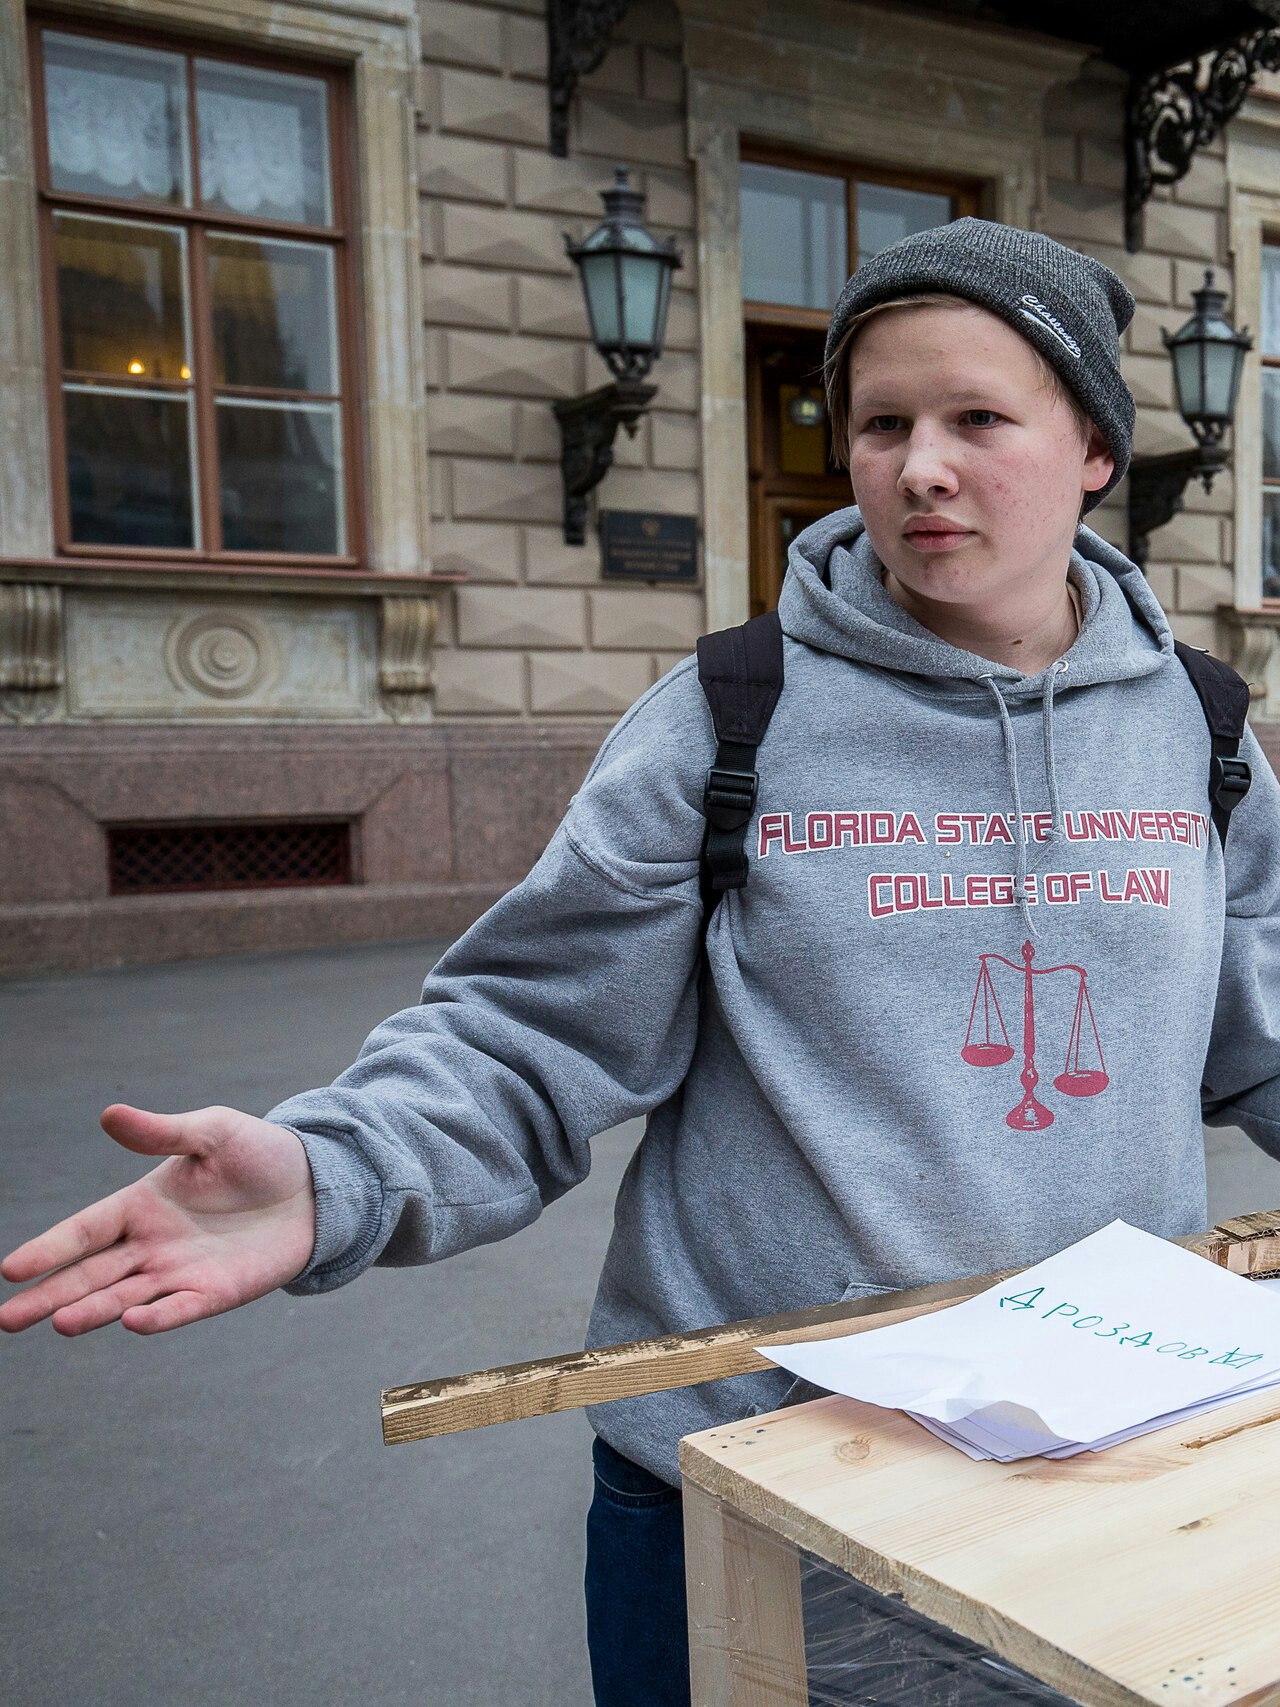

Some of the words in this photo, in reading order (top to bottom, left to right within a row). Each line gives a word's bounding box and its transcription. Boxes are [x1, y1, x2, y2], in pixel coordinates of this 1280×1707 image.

[758, 811, 928, 859] FLORIDA
[935, 812, 1053, 845] STATE
[1044, 872, 1093, 905] OF
[1098, 868, 1171, 909] LAW
